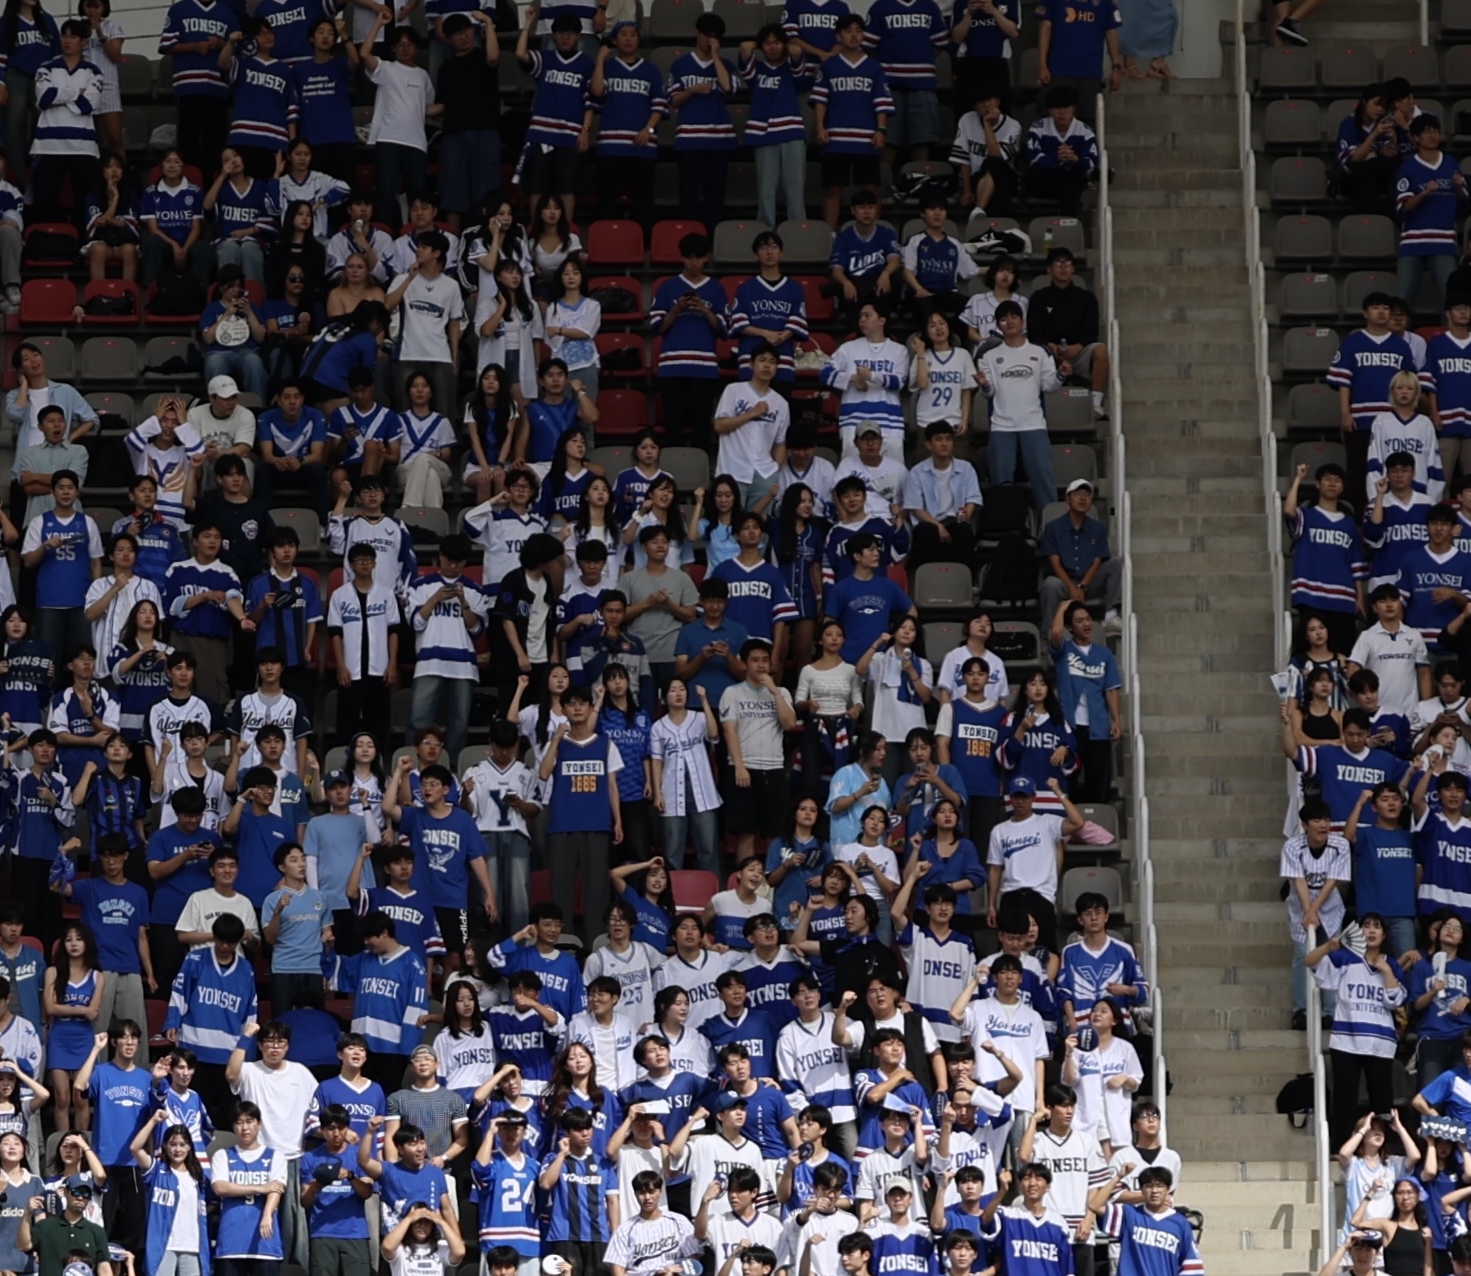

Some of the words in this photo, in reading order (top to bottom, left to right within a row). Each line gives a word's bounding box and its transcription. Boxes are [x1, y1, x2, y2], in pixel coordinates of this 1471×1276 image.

[1355, 352, 1403, 369] YONSEI
[932, 387, 952, 407] 29
[1417, 573, 1462, 587] YONSEI
[566, 763, 602, 773] YONSEI
[1337, 765, 1385, 784] YONSEI
[198, 986, 241, 1012] YONSEI
[562, 1173, 602, 1184] YONSEI
